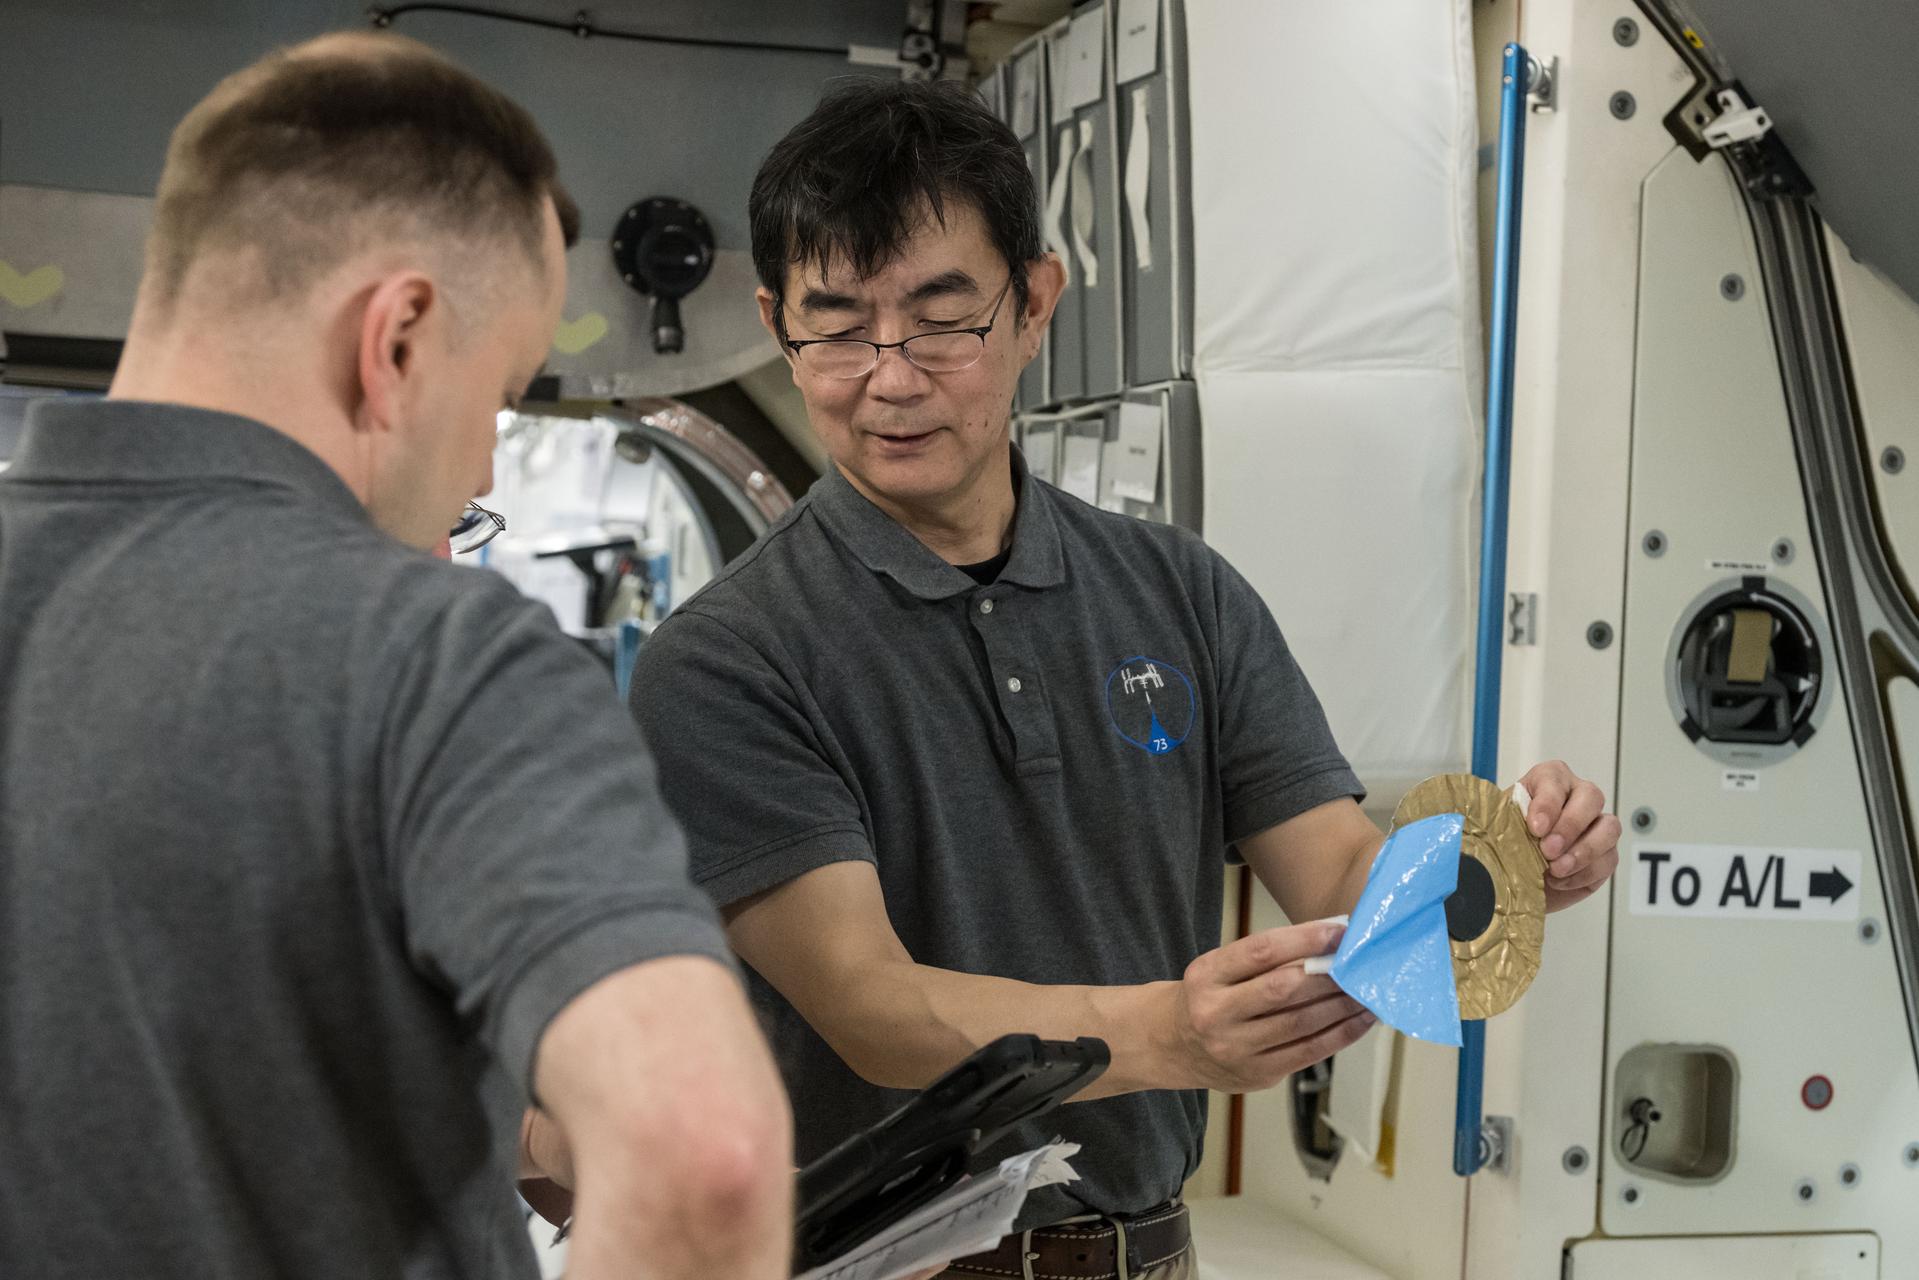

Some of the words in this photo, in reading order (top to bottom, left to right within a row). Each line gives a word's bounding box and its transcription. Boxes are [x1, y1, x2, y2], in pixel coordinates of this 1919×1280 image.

[1153, 738, 1168, 751] 73
[1639, 852, 1702, 907] To
[1718, 854, 1801, 909] A/L
